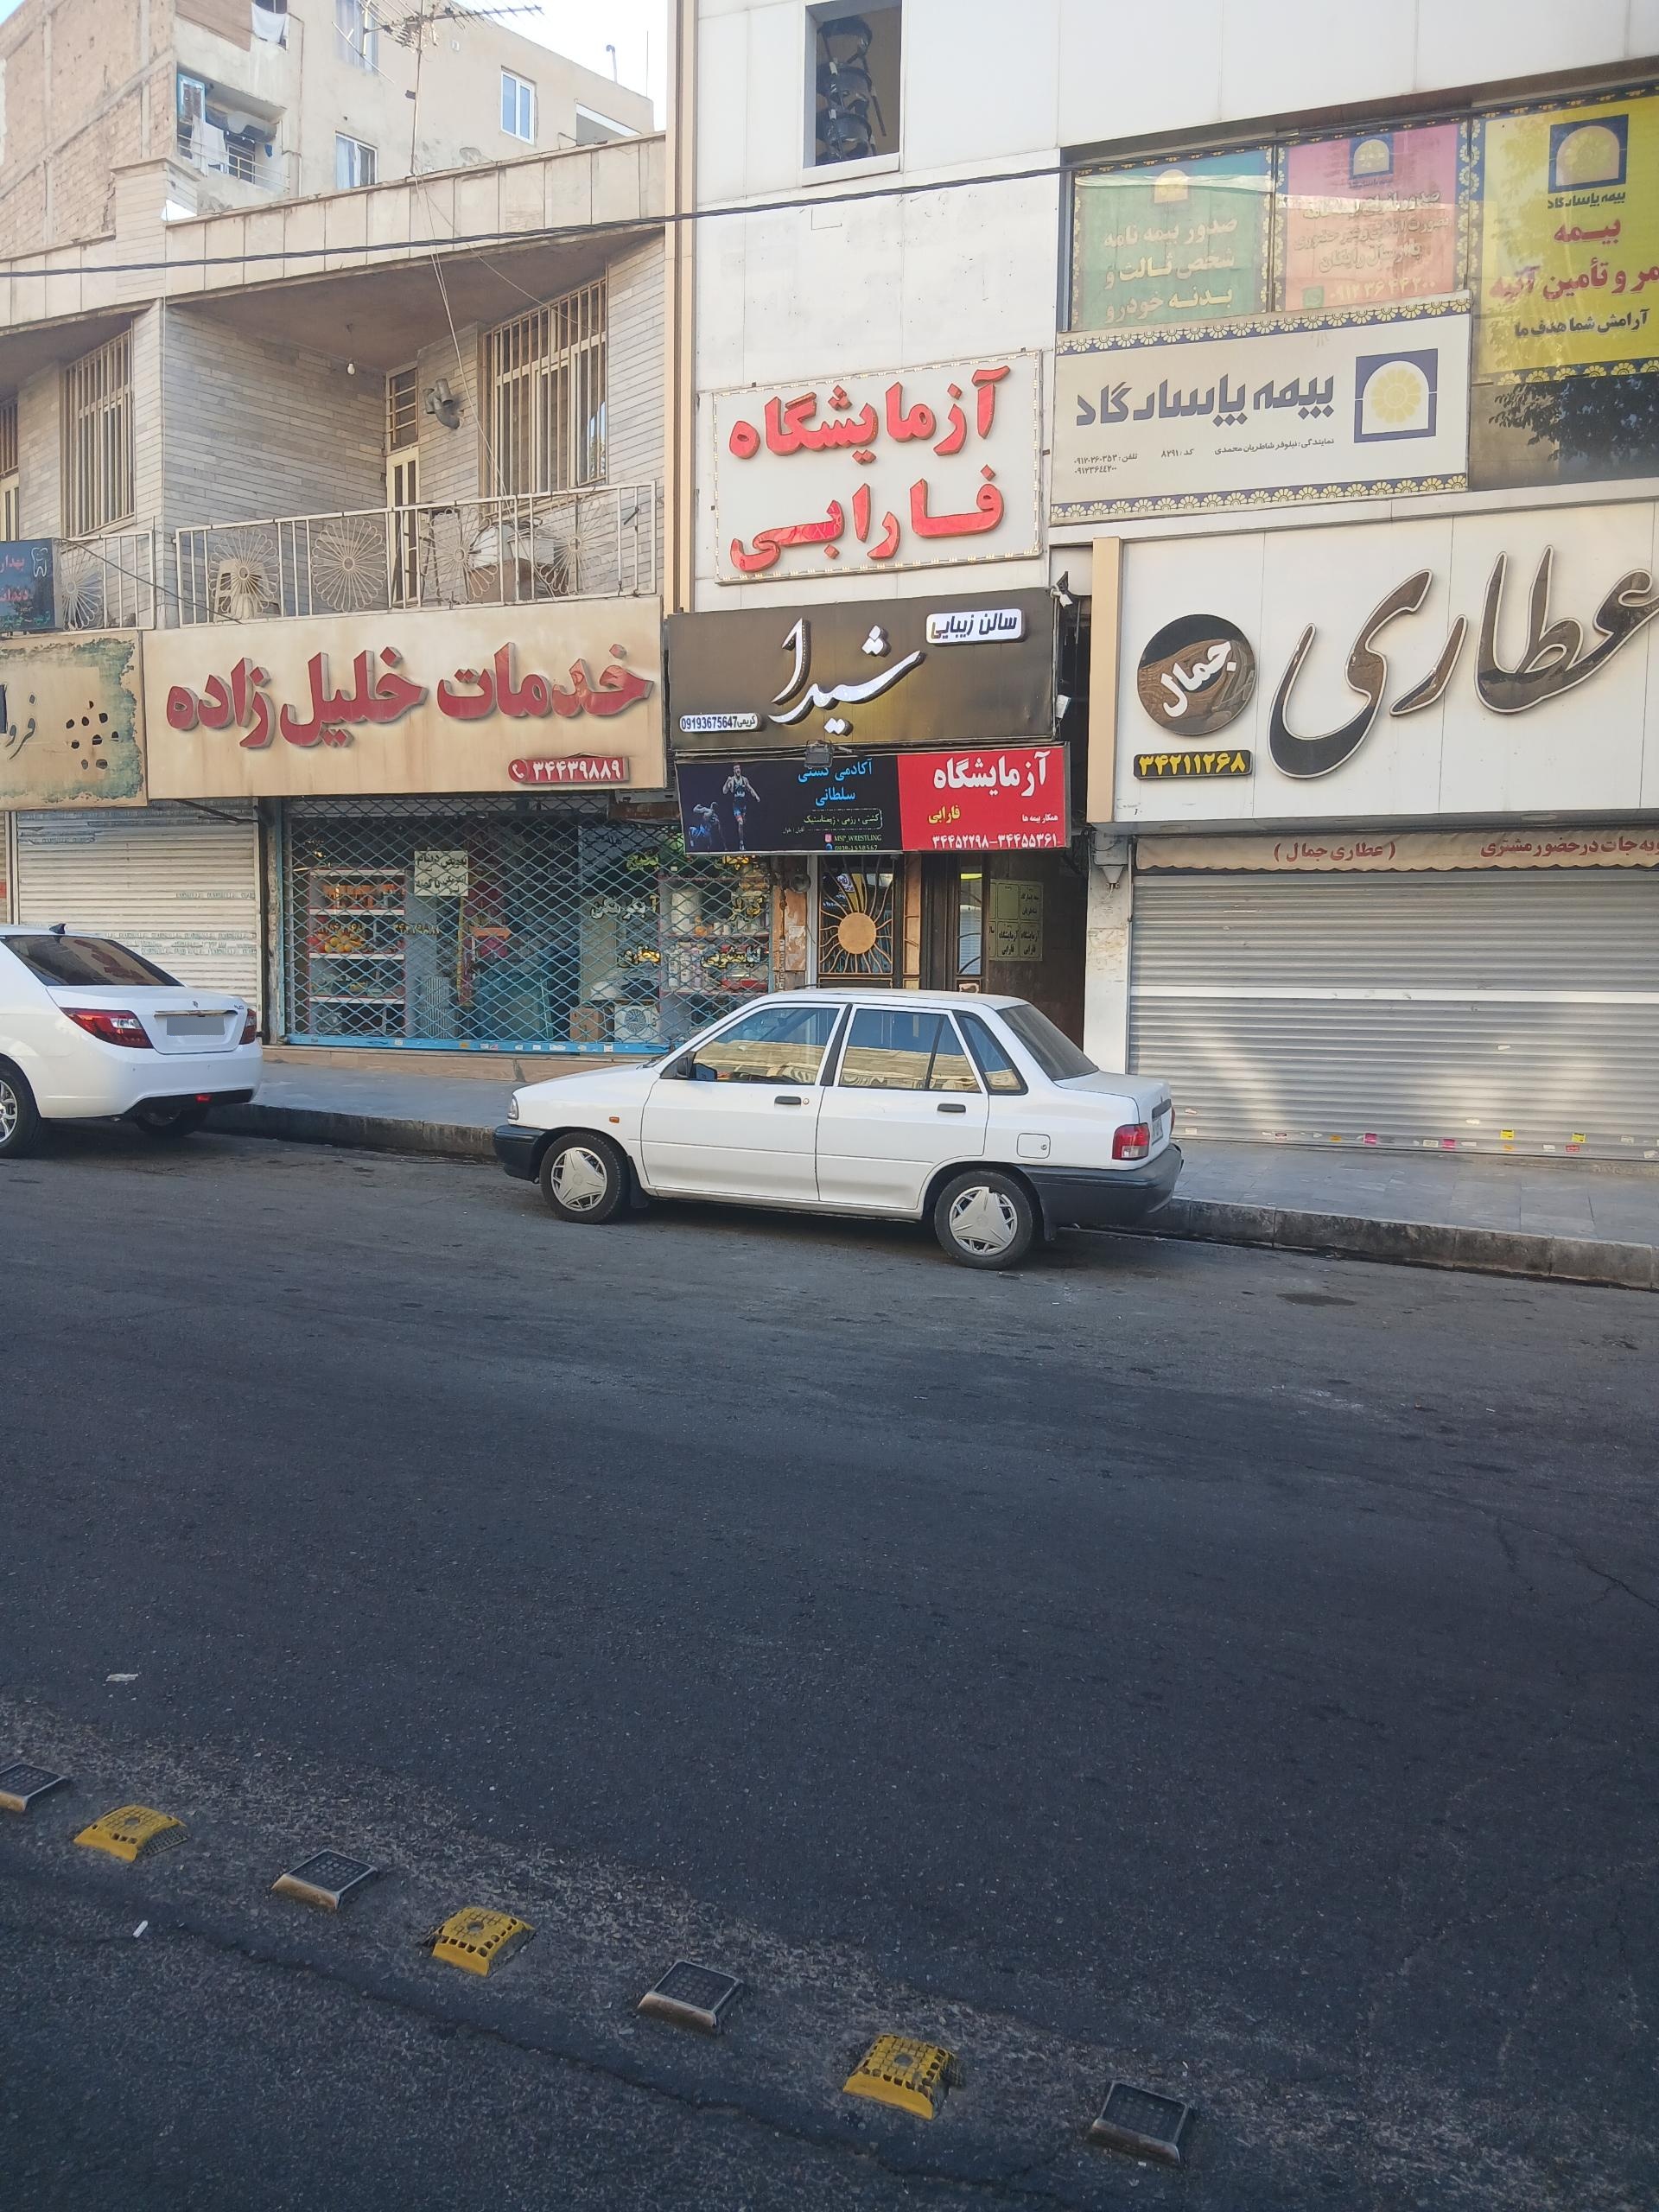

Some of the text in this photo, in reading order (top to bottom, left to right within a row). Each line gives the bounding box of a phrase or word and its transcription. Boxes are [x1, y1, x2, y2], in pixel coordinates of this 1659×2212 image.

[1548, 192, 1626, 209] بیمه پاسارگاد
[1103, 218, 1238, 248] صدور بیمه نامه
[1554, 219, 1621, 245] بیمه
[1119, 252, 1173, 281] ثالث
[1177, 248, 1235, 280] شخص
[1611, 270, 1626, 294] و
[1630, 264, 1659, 292] مر
[1104, 286, 1233, 324] بدنه خودرو
[1515, 308, 1650, 337] آرامش شما هدف ما
[1076, 372, 1335, 428] بیمه پاسارگاد
[728, 365, 1011, 466] آزمایشگاه
[729, 464, 1005, 574] فارابی
[931, 612, 1017, 639] سالن زیبایی
[1267, 544, 1659, 779] عطاری
[767, 617, 925, 735] شیدا
[1160, 640, 1236, 718] جمال
[166, 642, 654, 749] خدمات خلیل زاده
[681, 715, 738, 730] 09193675647
[532, 760, 621, 780] ۳۴۴۳۹۸۸۹
[835, 757, 873, 781] آکادمی
[934, 750, 1051, 797] آزمایشگاه
[1139, 752, 1246, 776] ۳۴۲۱۱۲۶۸
[815, 787, 855, 806] سلطانی
[928, 804, 960, 824] فارابی
[1041, 813, 1058, 823] همکار
[1286, 842, 1382, 862] عطاری جمال
[1480, 838, 1532, 857] مشتری
[1533, 837, 1580, 857] حضور
[1579, 840, 1599, 855] در
[1600, 836, 1637, 855] جات
